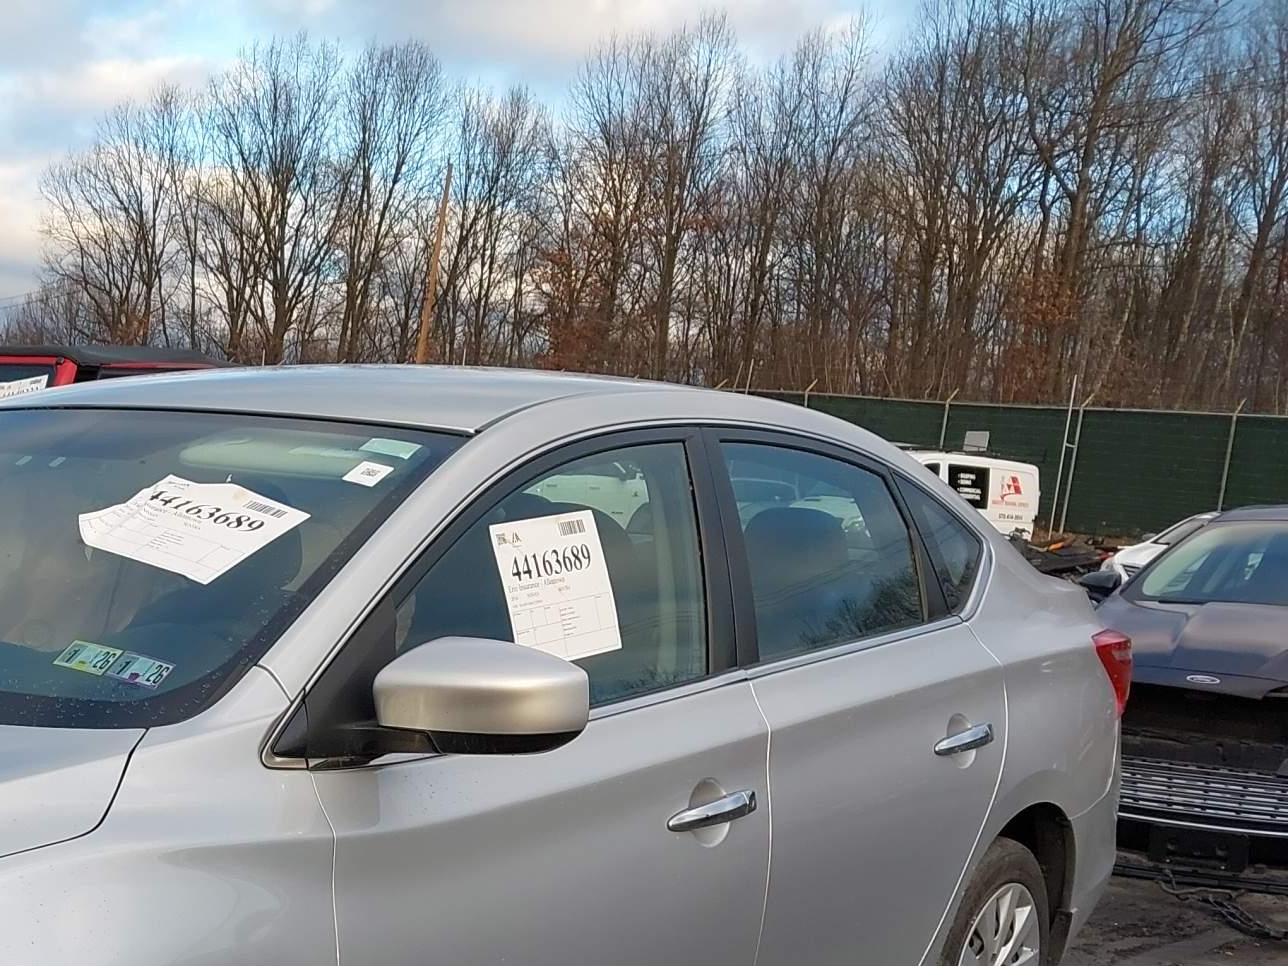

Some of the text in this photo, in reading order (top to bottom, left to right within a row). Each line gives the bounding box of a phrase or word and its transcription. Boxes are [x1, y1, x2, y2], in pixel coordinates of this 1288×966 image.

[150, 490, 265, 532] 44163689
[511, 543, 591, 581] 44163689
[92, 651, 117, 670] 26
[145, 664, 169, 684] 26
